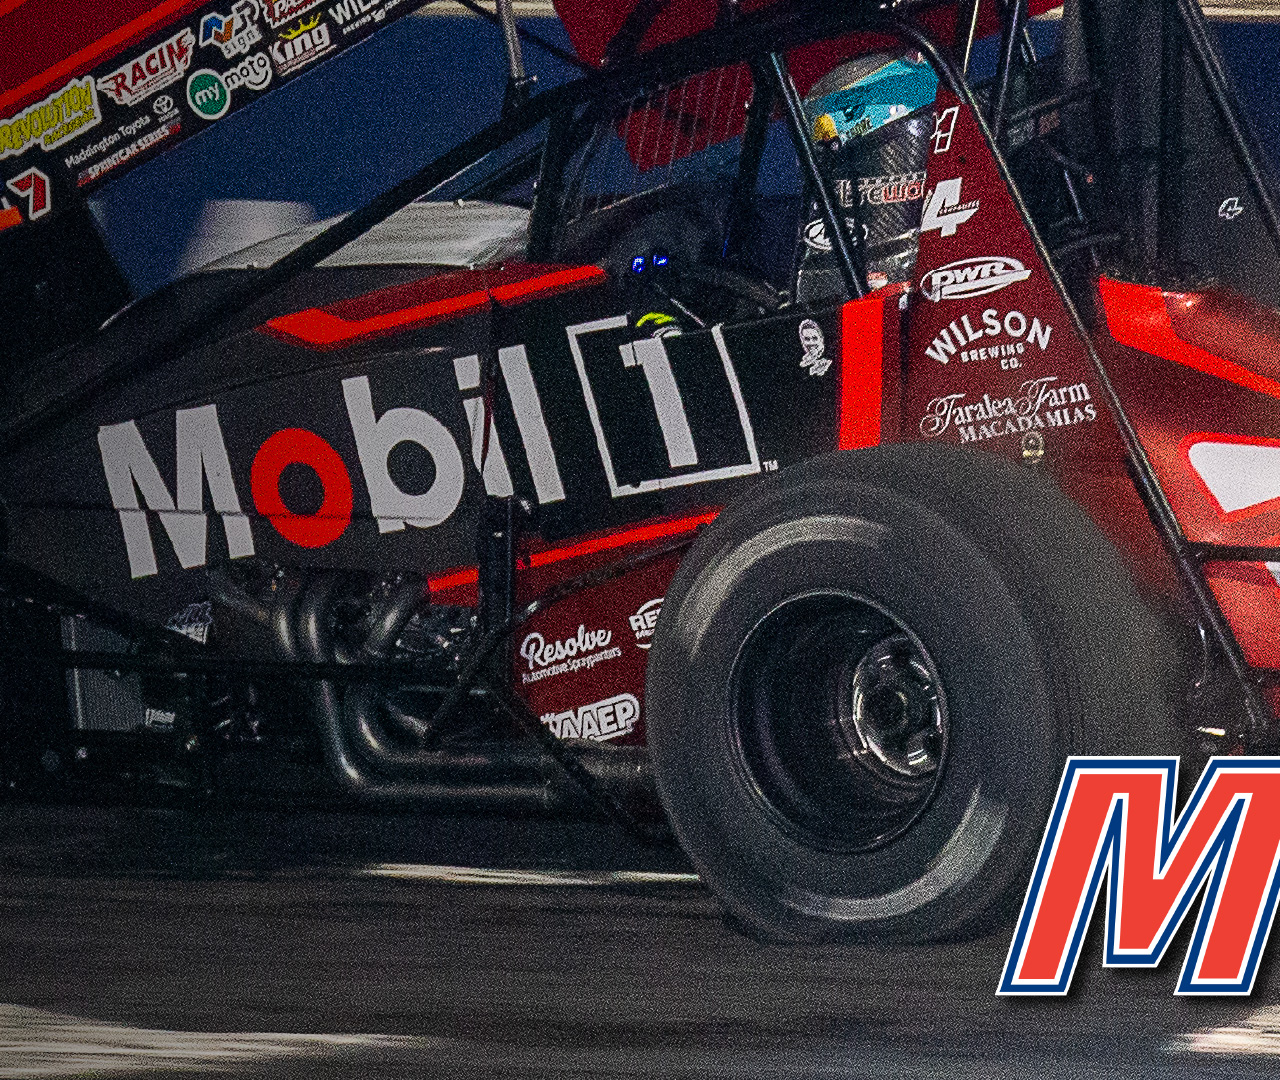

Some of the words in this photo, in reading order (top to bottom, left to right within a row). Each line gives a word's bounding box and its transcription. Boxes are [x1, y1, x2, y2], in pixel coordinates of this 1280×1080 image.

[194, 80, 221, 106] my
[224, 53, 267, 89] moto
[64, 132, 121, 168] Maddington
[118, 114, 151, 139] Toyota
[136, 125, 171, 153] SERIES
[929, 259, 1019, 303] PWR
[925, 308, 1054, 365] WILSON
[960, 341, 1025, 363] BREWING
[1000, 357, 1024, 371] CO.
[959, 403, 1098, 444] MACADAMIAS
[96, 343, 566, 580] Mobil
[520, 624, 613, 671] Resolve
